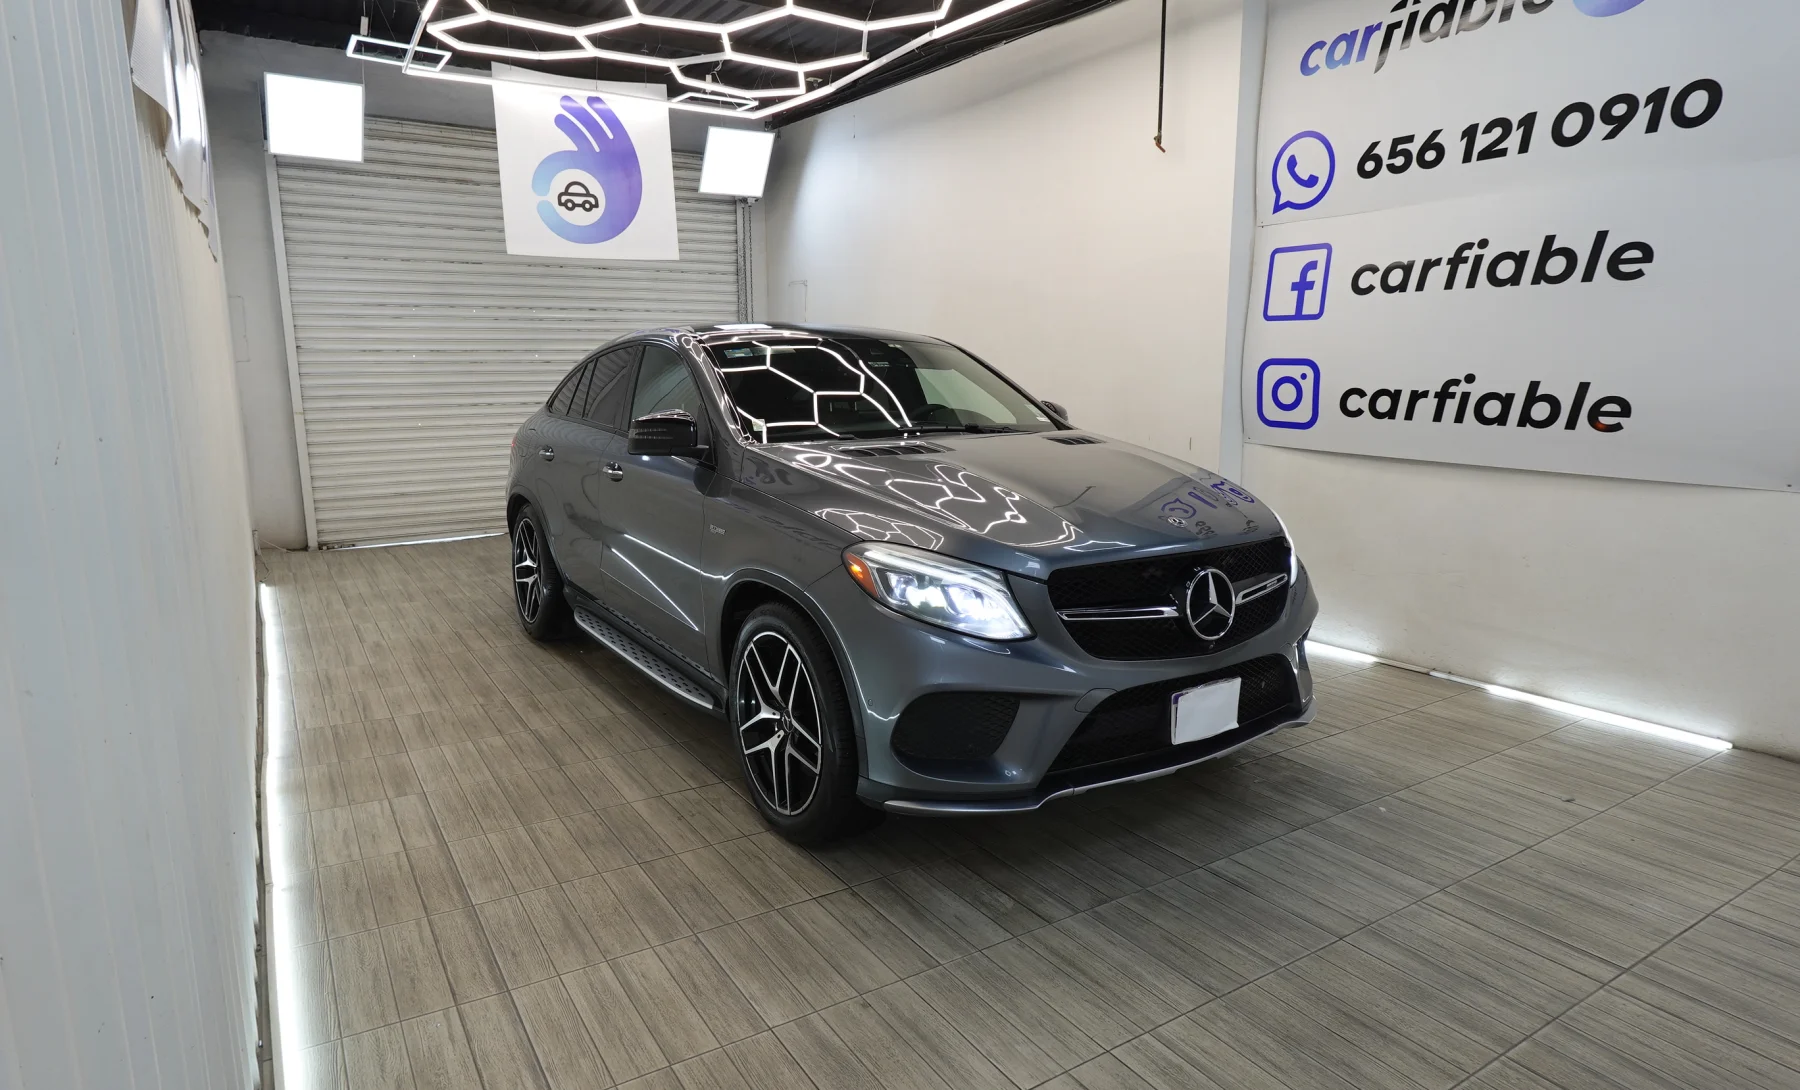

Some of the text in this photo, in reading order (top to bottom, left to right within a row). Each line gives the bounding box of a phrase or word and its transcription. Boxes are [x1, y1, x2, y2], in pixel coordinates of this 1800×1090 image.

[1356, 78, 1725, 181] 656 121 0910
[1350, 229, 1656, 297] carfiable
[1339, 372, 1633, 434] carfiable
